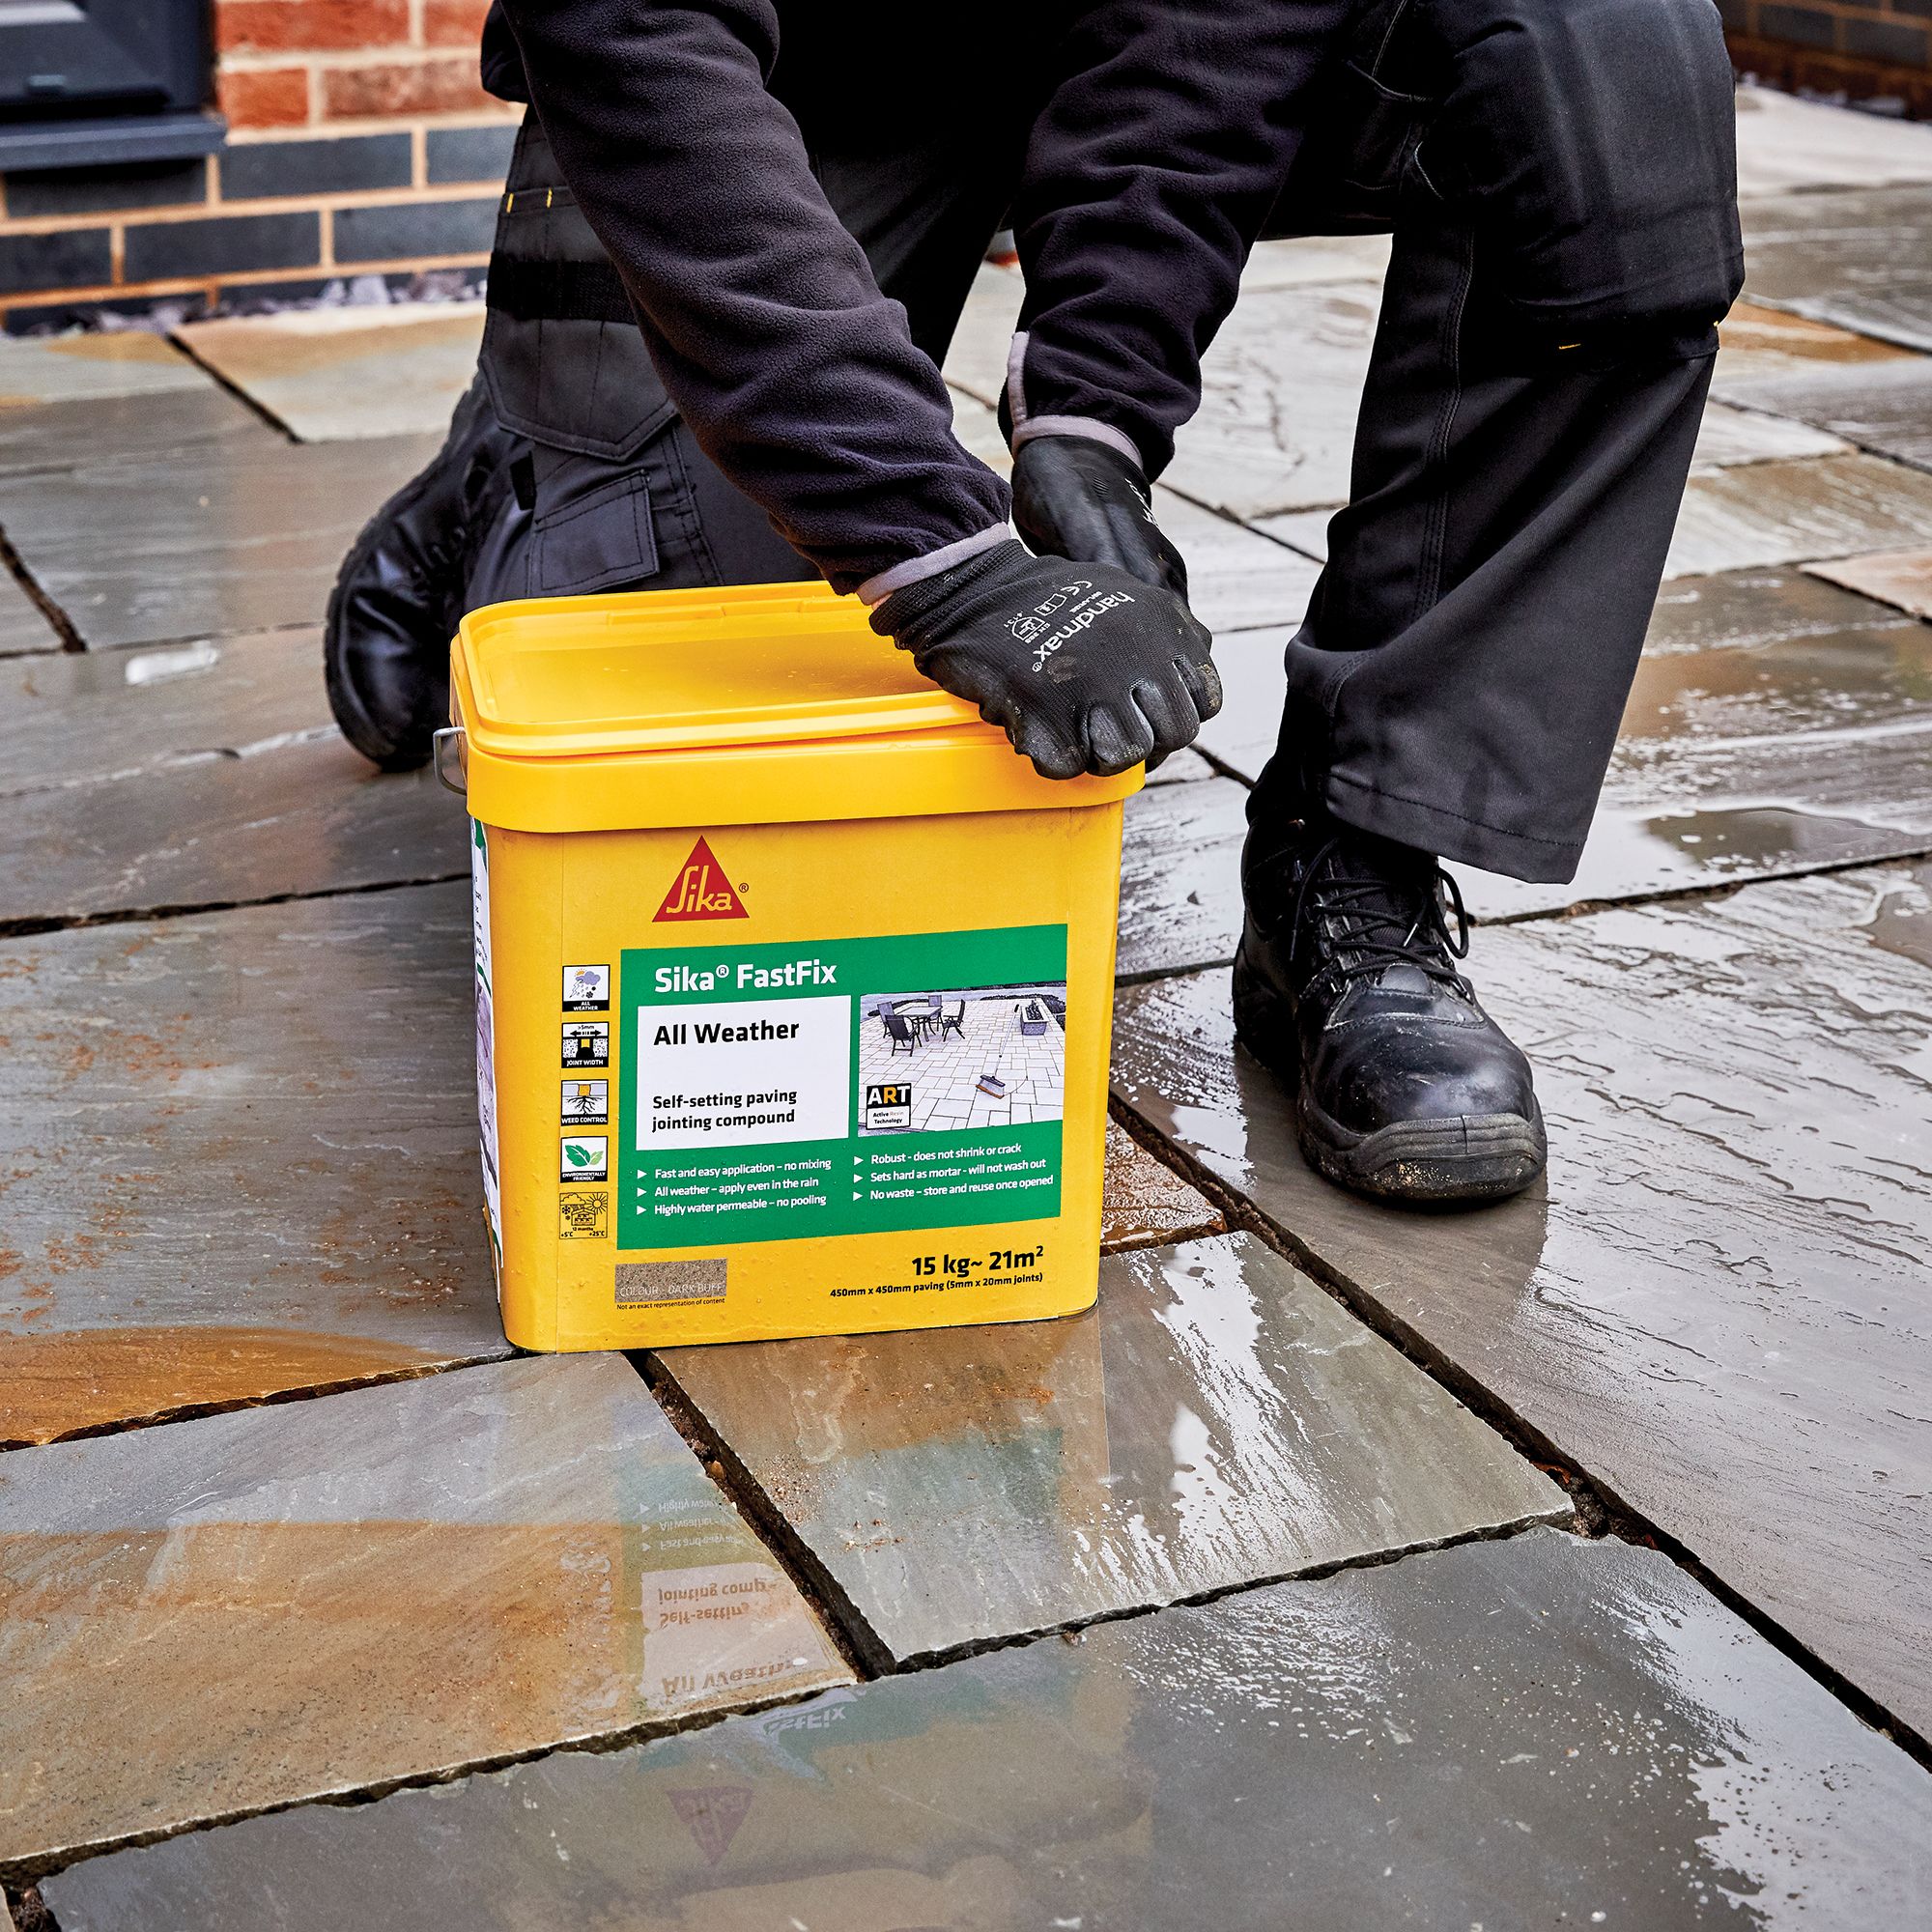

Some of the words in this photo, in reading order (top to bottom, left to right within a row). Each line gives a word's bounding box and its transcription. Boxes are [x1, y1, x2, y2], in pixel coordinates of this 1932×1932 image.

[737, 958, 838, 989] FastFix
[653, 1023, 687, 1045] All
[694, 1019, 800, 1043] Weather
[652, 1092, 743, 1109] Self-setting
[746, 1089, 797, 1108] paving
[867, 1085, 911, 1105] ART
[652, 1115, 712, 1133] jointing
[716, 1108, 795, 1128] compound
[871, 1154, 906, 1165] Robust
[914, 1151, 936, 1162] does
[938, 1150, 953, 1160] not
[955, 1147, 985, 1158] shrink
[986, 1147, 997, 1155] or
[997, 1143, 1021, 1154] crack
[655, 1168, 677, 1179] Fast
[678, 1167, 696, 1178] and
[698, 1167, 721, 1179] easy
[722, 1164, 775, 1177] application
[784, 1162, 797, 1171] no
[799, 1159, 832, 1171] mixing
[870, 1172, 892, 1182] Sets
[893, 1170, 915, 1180] hard
[916, 1171, 927, 1179] as
[929, 1168, 961, 1179] mortar
[968, 1163, 985, 1175] will
[986, 1163, 1003, 1174] not
[1004, 1160, 1029, 1172] wash
[1030, 1158, 1046, 1169] out
[655, 1186, 668, 1197] All
[669, 1184, 710, 1196] weather
[719, 1182, 746, 1195] apply
[747, 1182, 770, 1191] even
[772, 1179, 781, 1189] in
[782, 1179, 799, 1189] the
[801, 1177, 818, 1187] rain
[870, 1190, 885, 1200] No
[886, 1189, 915, 1199] waste
[923, 1186, 948, 1196] store
[949, 1183, 967, 1194] and
[969, 1183, 995, 1193] reuse
[996, 1180, 1018, 1190] once
[1019, 1175, 1054, 1189] opened
[655, 1204, 686, 1217] Highly
[687, 1204, 715, 1214] water
[716, 1199, 767, 1213] permeable
[777, 1198, 789, 1208] no
[790, 1195, 827, 1208] pooling
[911, 1257, 936, 1276] 15
[619, 1286, 659, 1297] COLOUR
[668, 1283, 696, 1294] DARK
[697, 1282, 724, 1293] BUFF
[830, 1288, 866, 1297] 450mm
[875, 1285, 911, 1294] 450mm
[913, 1281, 945, 1293] paving
[947, 1280, 973, 1291] (5mm
[982, 1277, 1012, 1287] 20mm
[1013, 1272, 1043, 1286] joints)
